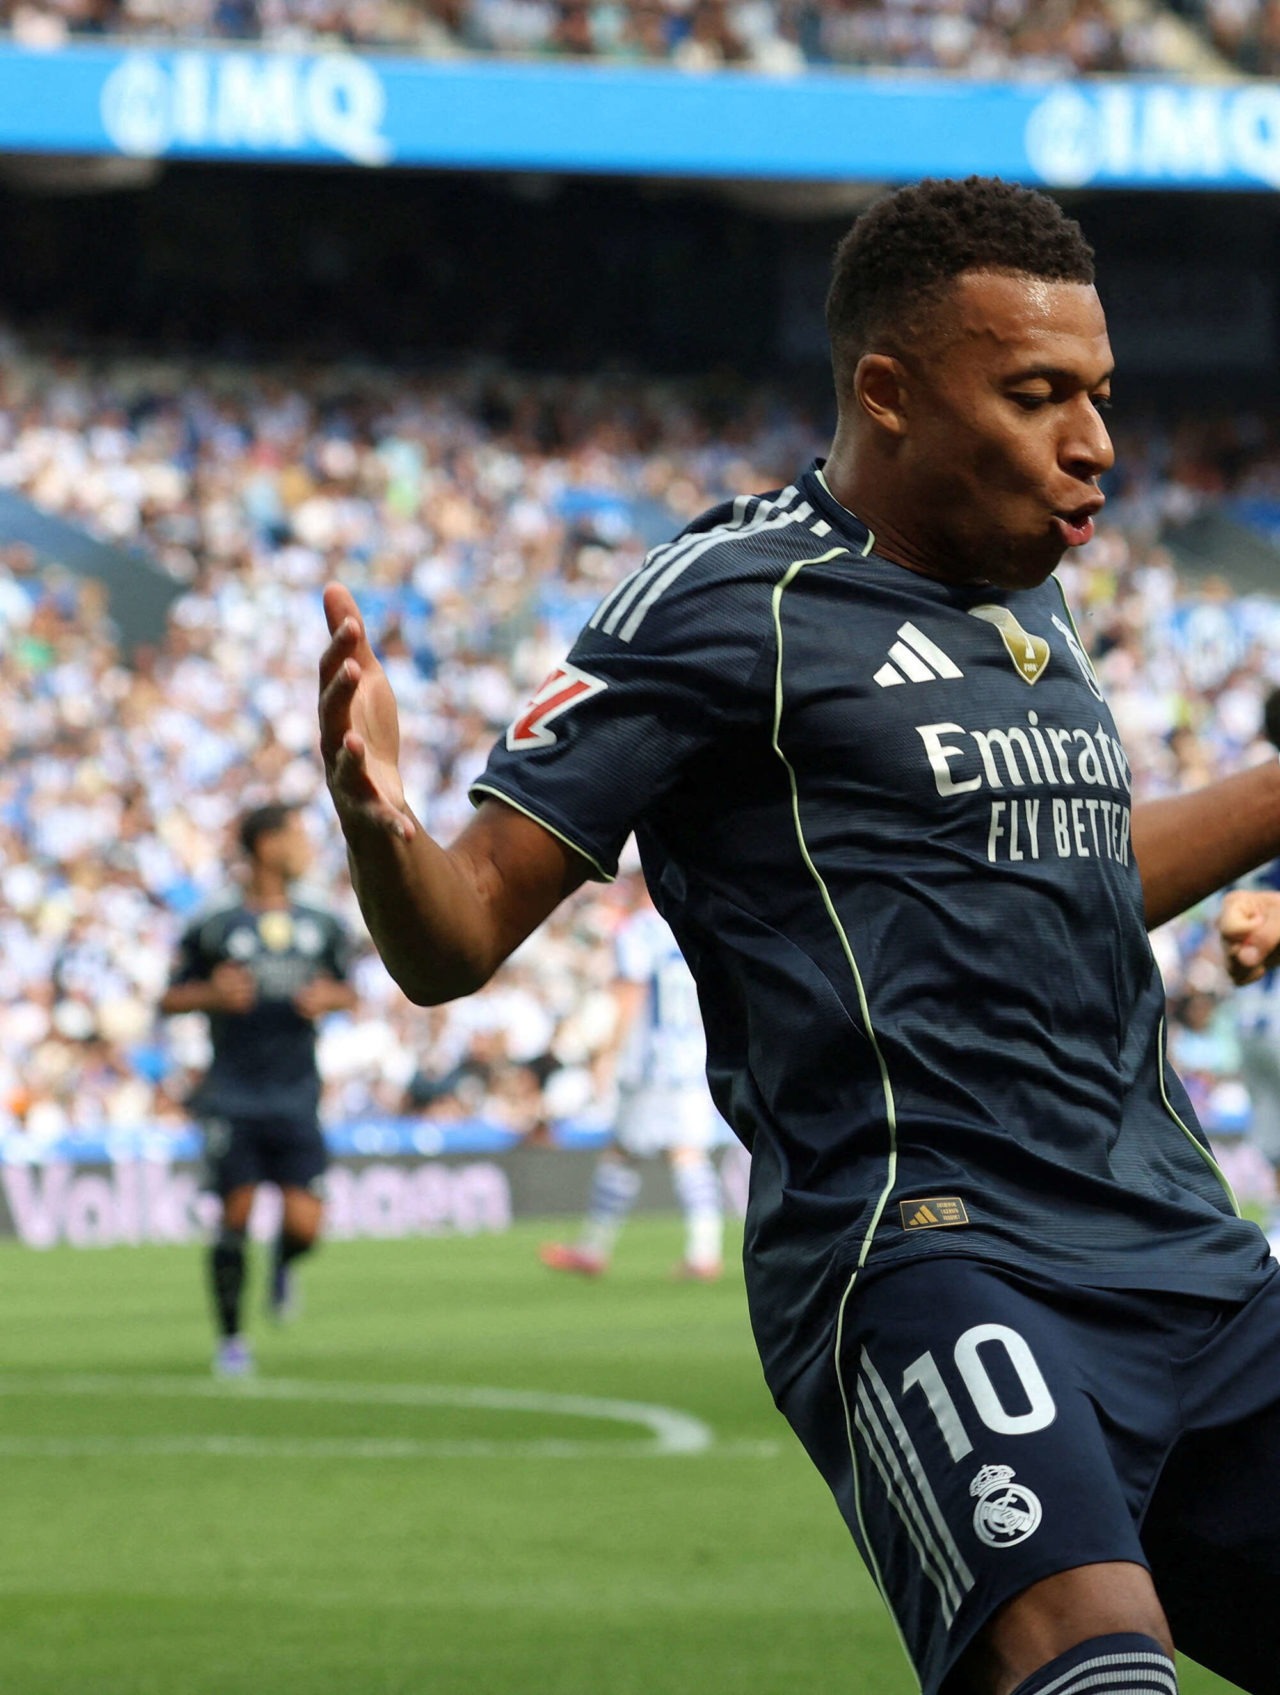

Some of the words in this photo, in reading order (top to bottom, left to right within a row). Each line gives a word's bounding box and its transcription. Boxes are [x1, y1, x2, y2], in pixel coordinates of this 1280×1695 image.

[173, 50, 396, 167] IMQ
[915, 710, 1131, 797] Emirate
[987, 799, 1040, 862] FLY
[1053, 799, 1131, 867] BETTER
[2, 1155, 513, 1248] Volkgen
[902, 1323, 1057, 1462] 10
